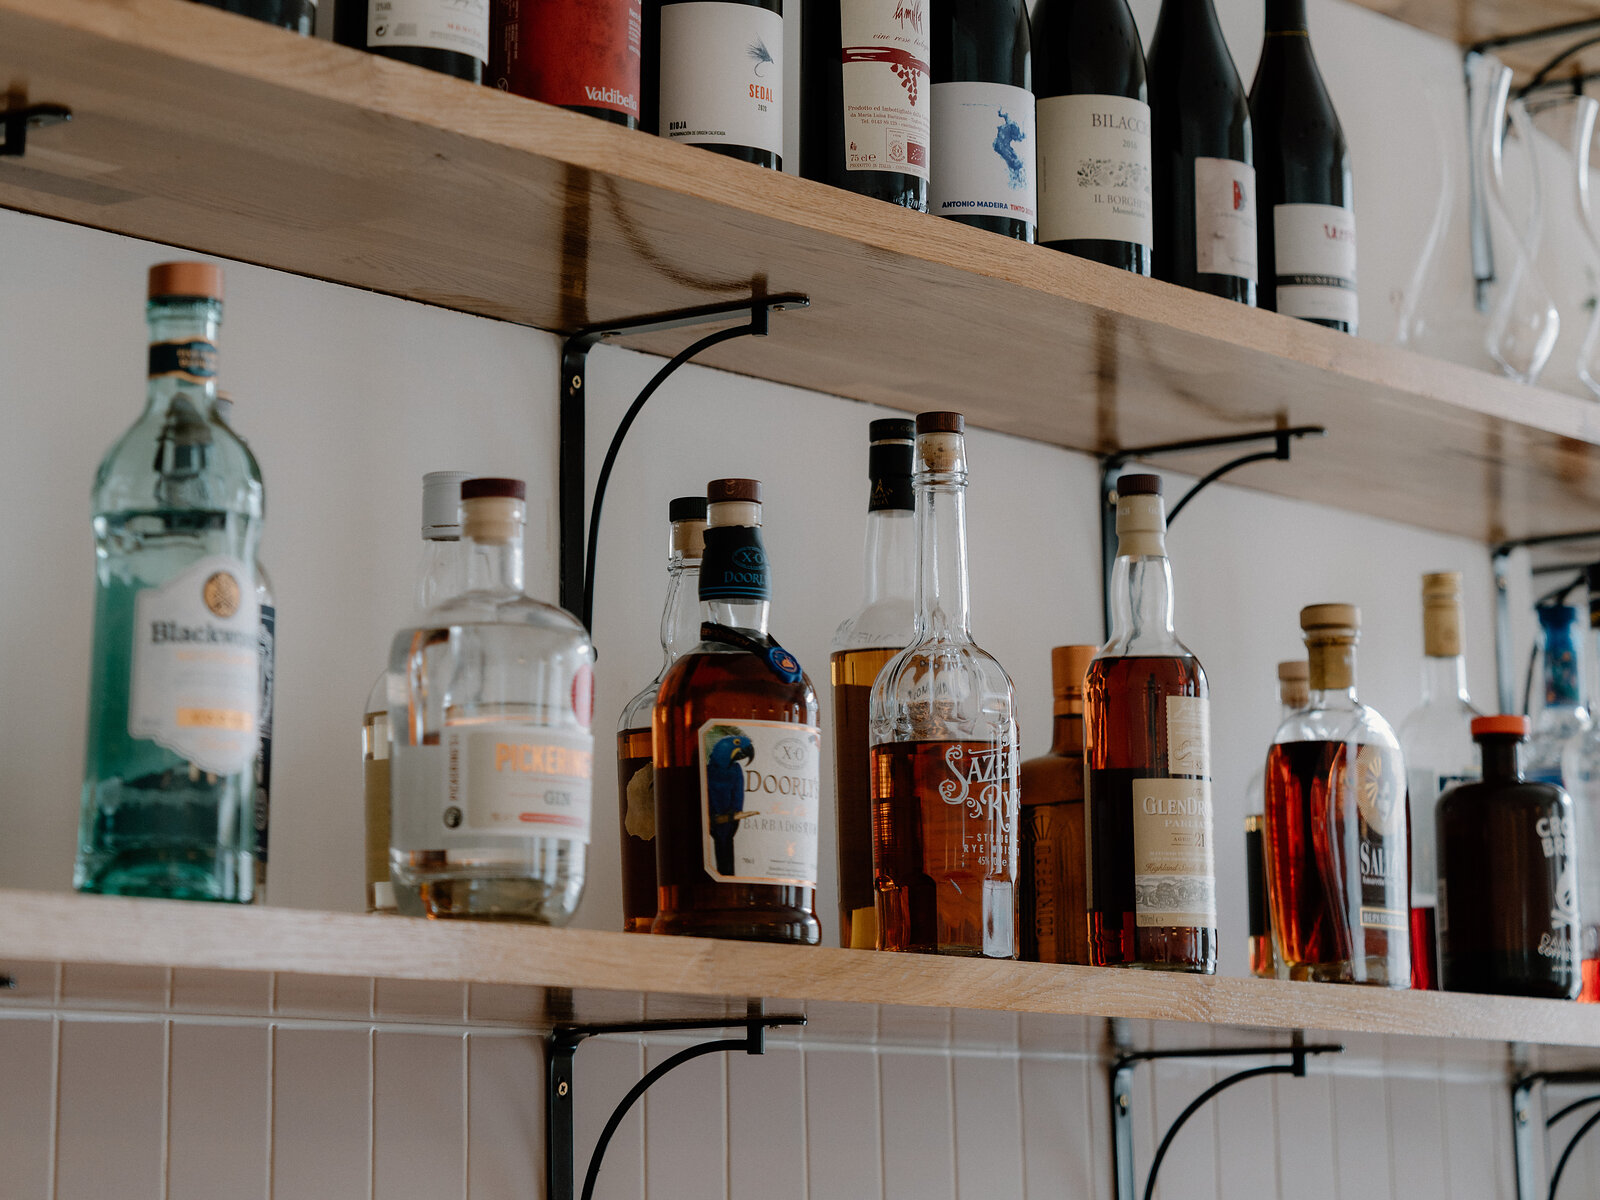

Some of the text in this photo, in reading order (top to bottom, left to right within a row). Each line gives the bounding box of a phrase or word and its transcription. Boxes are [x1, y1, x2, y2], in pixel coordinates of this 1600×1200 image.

[749, 84, 774, 103] SEDAL
[669, 121, 687, 131] RIOJA
[850, 154, 859, 162] 75
[1094, 194, 1104, 204] IL
[942, 200, 976, 209] ANTONIO
[976, 200, 1008, 210] MADEIRA
[543, 790, 571, 806] GIN
[963, 844, 984, 854] RYE
